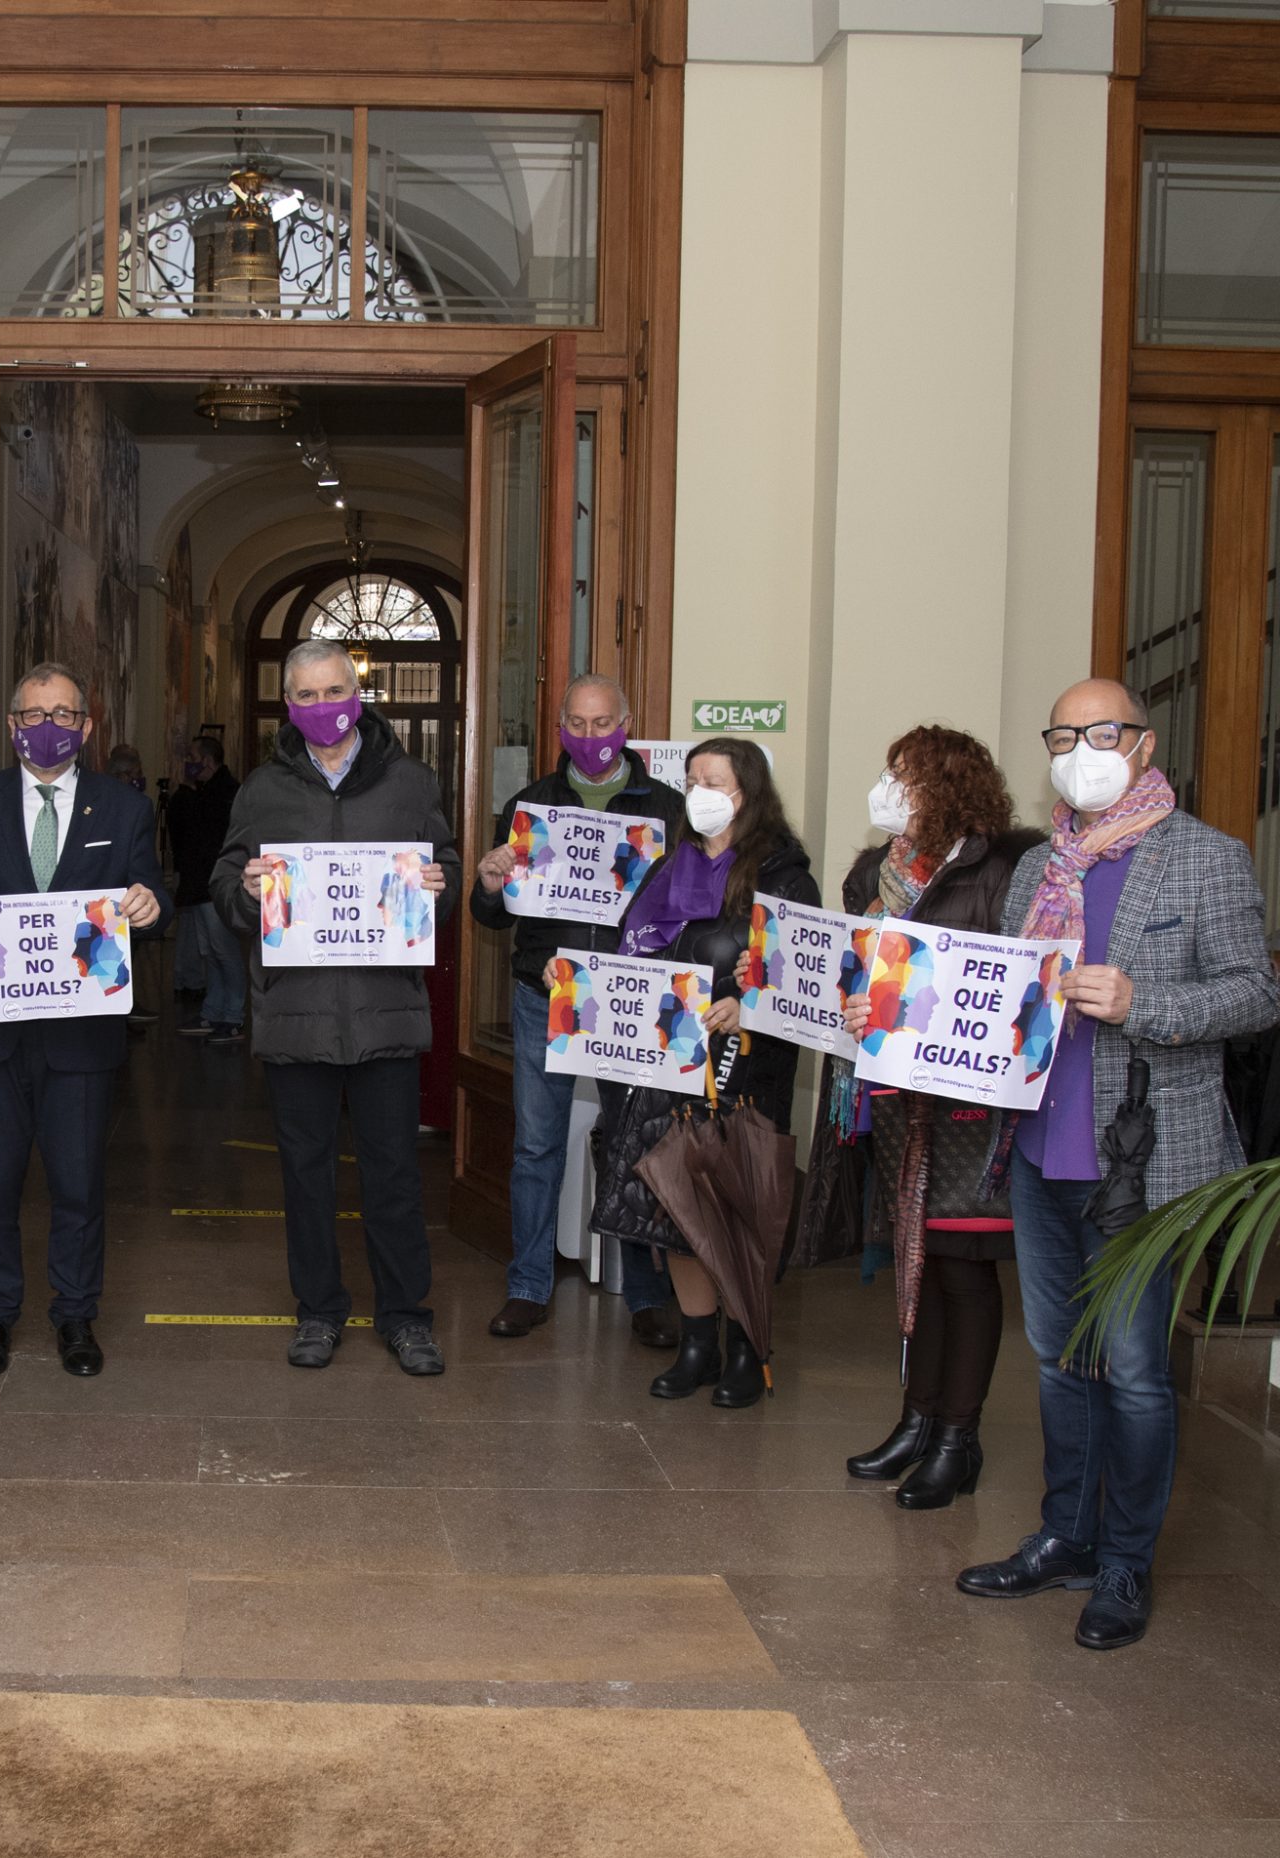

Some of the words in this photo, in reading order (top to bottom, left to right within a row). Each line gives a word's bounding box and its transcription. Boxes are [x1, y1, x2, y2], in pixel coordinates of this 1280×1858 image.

[713, 706, 755, 724] DEA
[566, 813, 596, 822] INTERNACIONAL
[563, 825, 605, 843] ¿POR
[566, 845, 601, 862] QUÉ
[569, 866, 595, 881] NO
[19, 913, 55, 929] PER
[332, 907, 360, 921] NO
[793, 911, 821, 923] INTERNACIONAL
[18, 933, 59, 953] QUÈ
[313, 929, 386, 944] GUALS?
[791, 927, 832, 950] ¿POR
[952, 940, 961, 948] DIA
[963, 941, 1005, 954] INTERNACIONAL
[1007, 947, 1014, 955] DE
[25, 958, 54, 974] NO
[608, 961, 638, 971] INTERNACIONAL
[794, 952, 826, 975] QUÉ
[962, 958, 1007, 982] PER
[0, 980, 82, 999] IGUALS?
[606, 975, 650, 993] ¿POR
[798, 978, 820, 998] NO
[609, 998, 644, 1016] QUÉ
[954, 988, 1003, 1013] QUÈ
[772, 996, 845, 1031] IGUALES?
[613, 1021, 638, 1039] NO
[952, 1018, 988, 1041] NO
[585, 1040, 666, 1066] IGUALES?
[913, 1042, 1012, 1076] IGUALS?
[951, 1109, 987, 1120] GUESS
